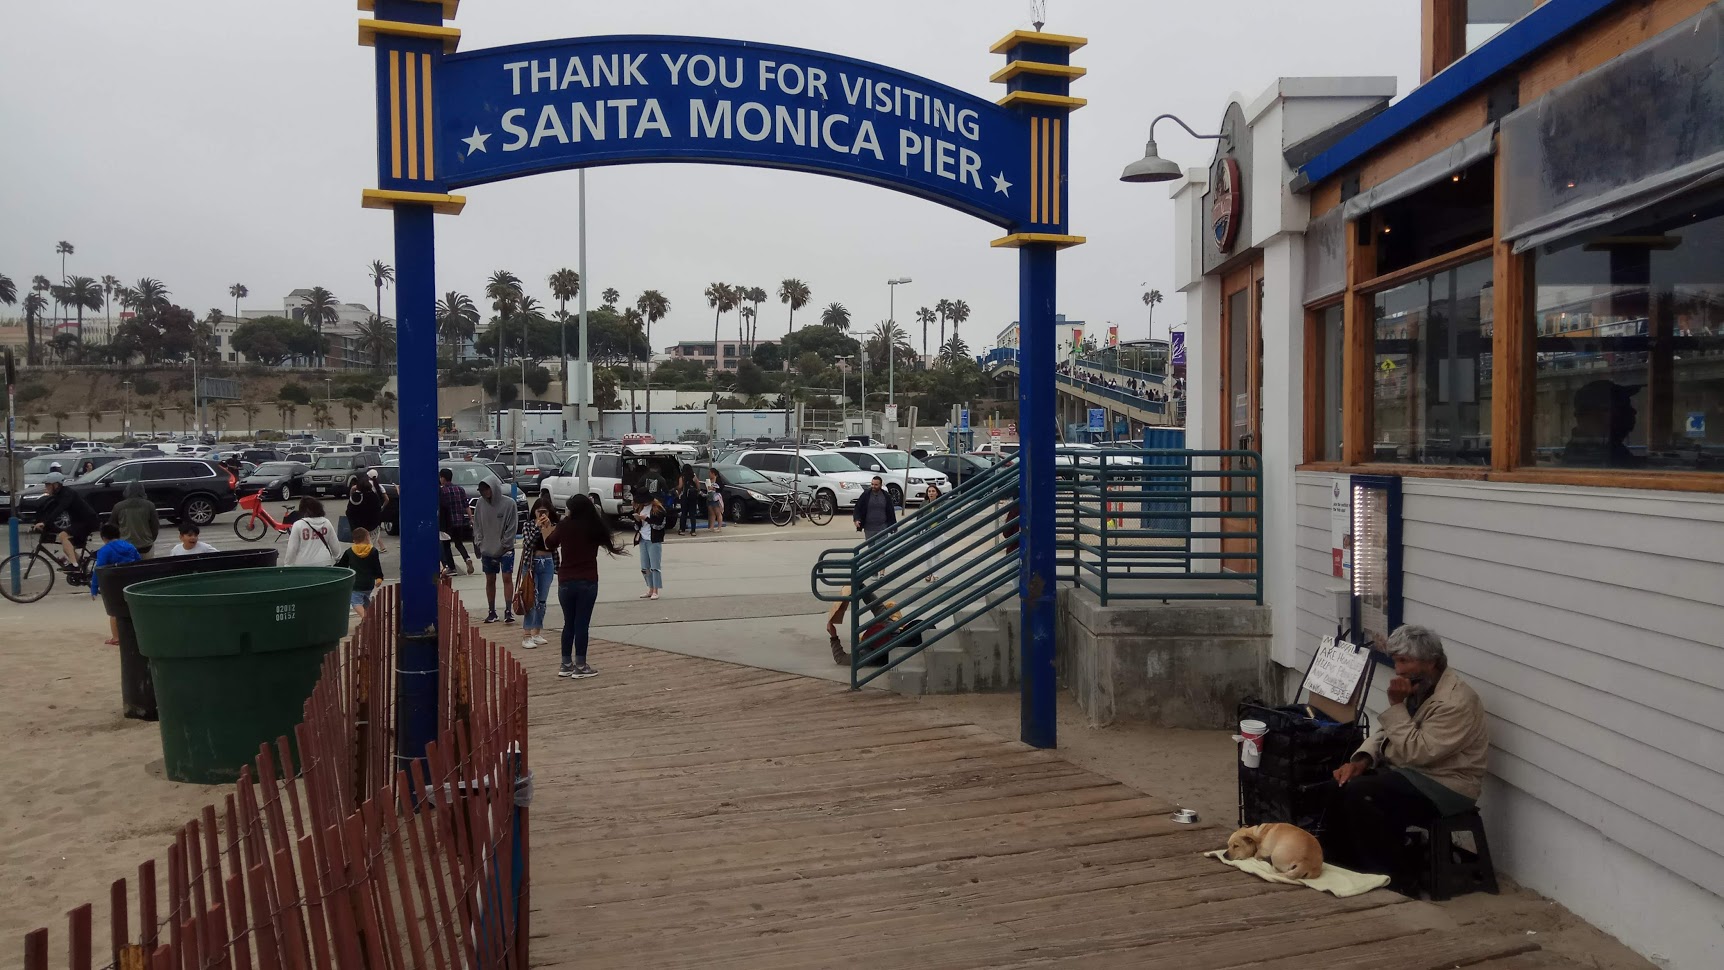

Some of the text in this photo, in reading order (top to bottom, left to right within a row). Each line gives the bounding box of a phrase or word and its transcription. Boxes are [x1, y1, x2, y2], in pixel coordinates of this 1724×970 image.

[503, 53, 981, 141] THANK YOU FOR VISITING
[501, 98, 983, 190] SANTA MONICA PIER
[302, 527, 328, 540] GAP
